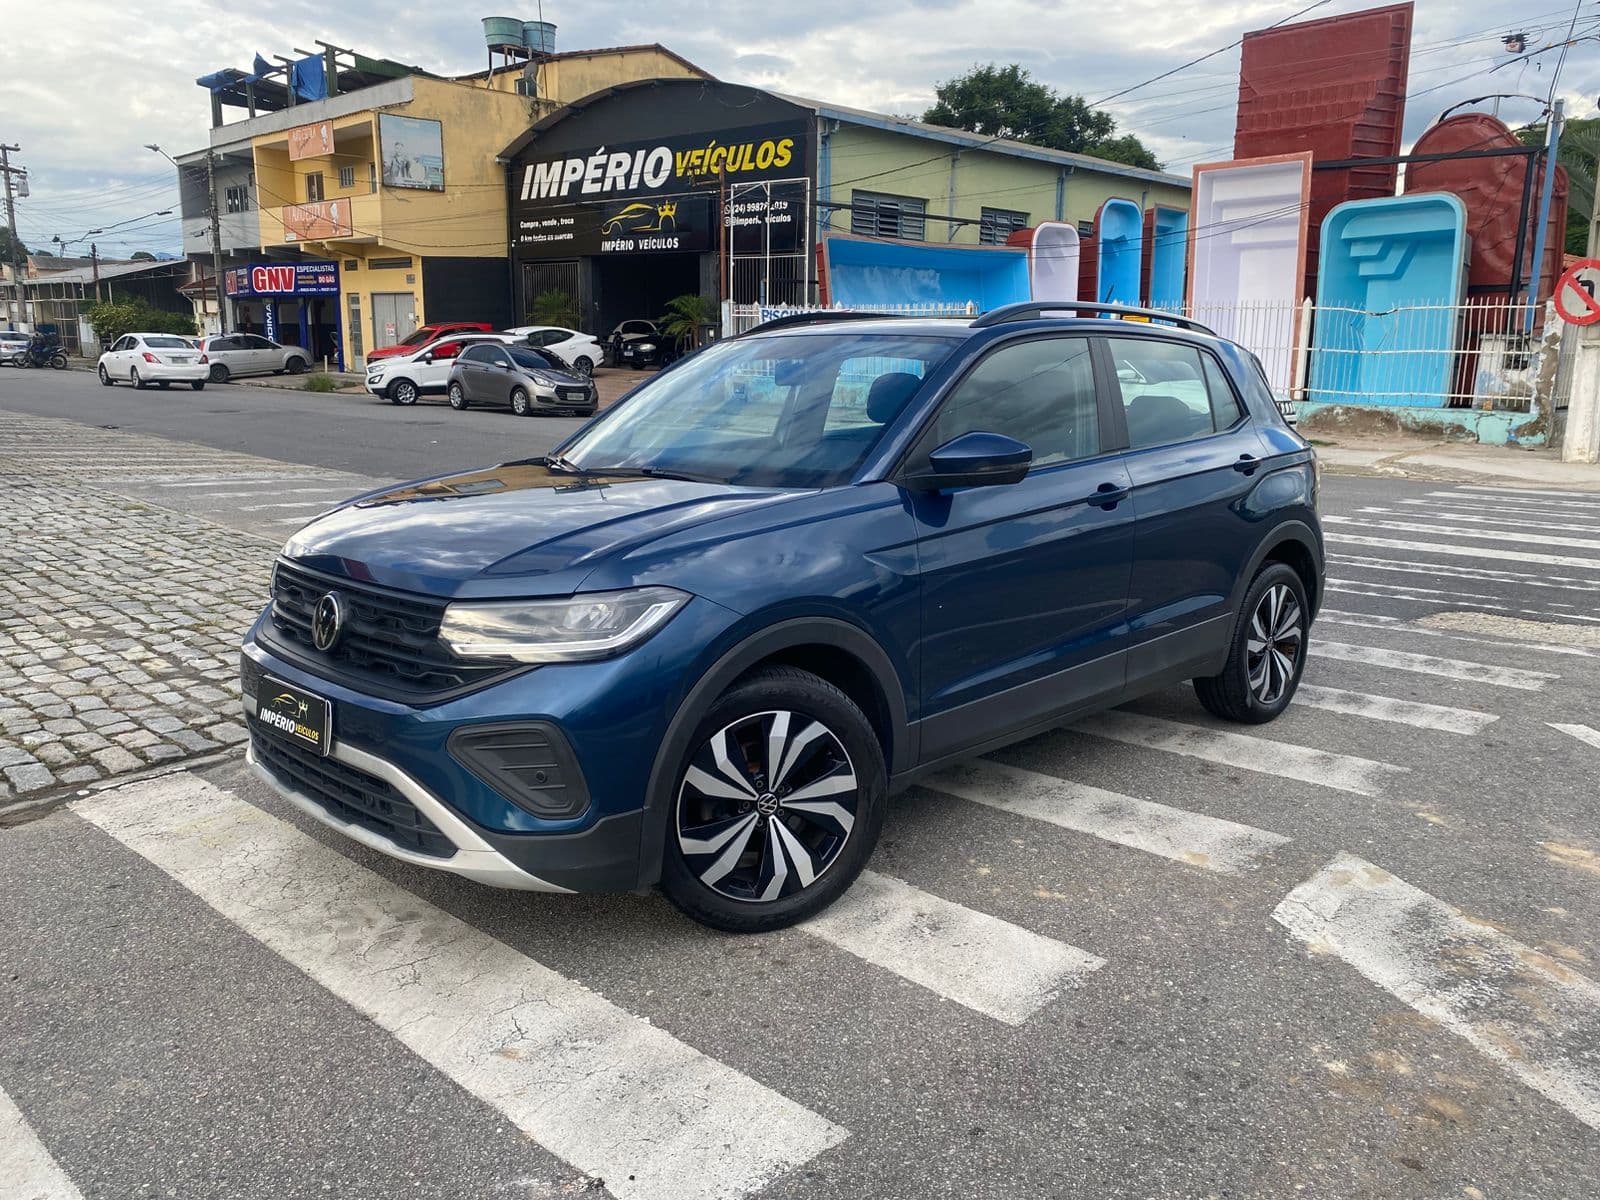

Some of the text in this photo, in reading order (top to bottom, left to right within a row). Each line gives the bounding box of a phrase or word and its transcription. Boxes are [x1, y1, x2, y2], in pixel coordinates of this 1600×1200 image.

[520, 138, 794, 200] IMPÉRIO VEÍCULOS
[560, 217, 574, 225] troca
[601, 236, 679, 251] IMPÉRIO VEÍCULOS
[252, 266, 295, 292] GNV
[296, 265, 335, 273] ESPECIALISTAS
[260, 707, 319, 740] IMPÉRIO VEÍCULOS
